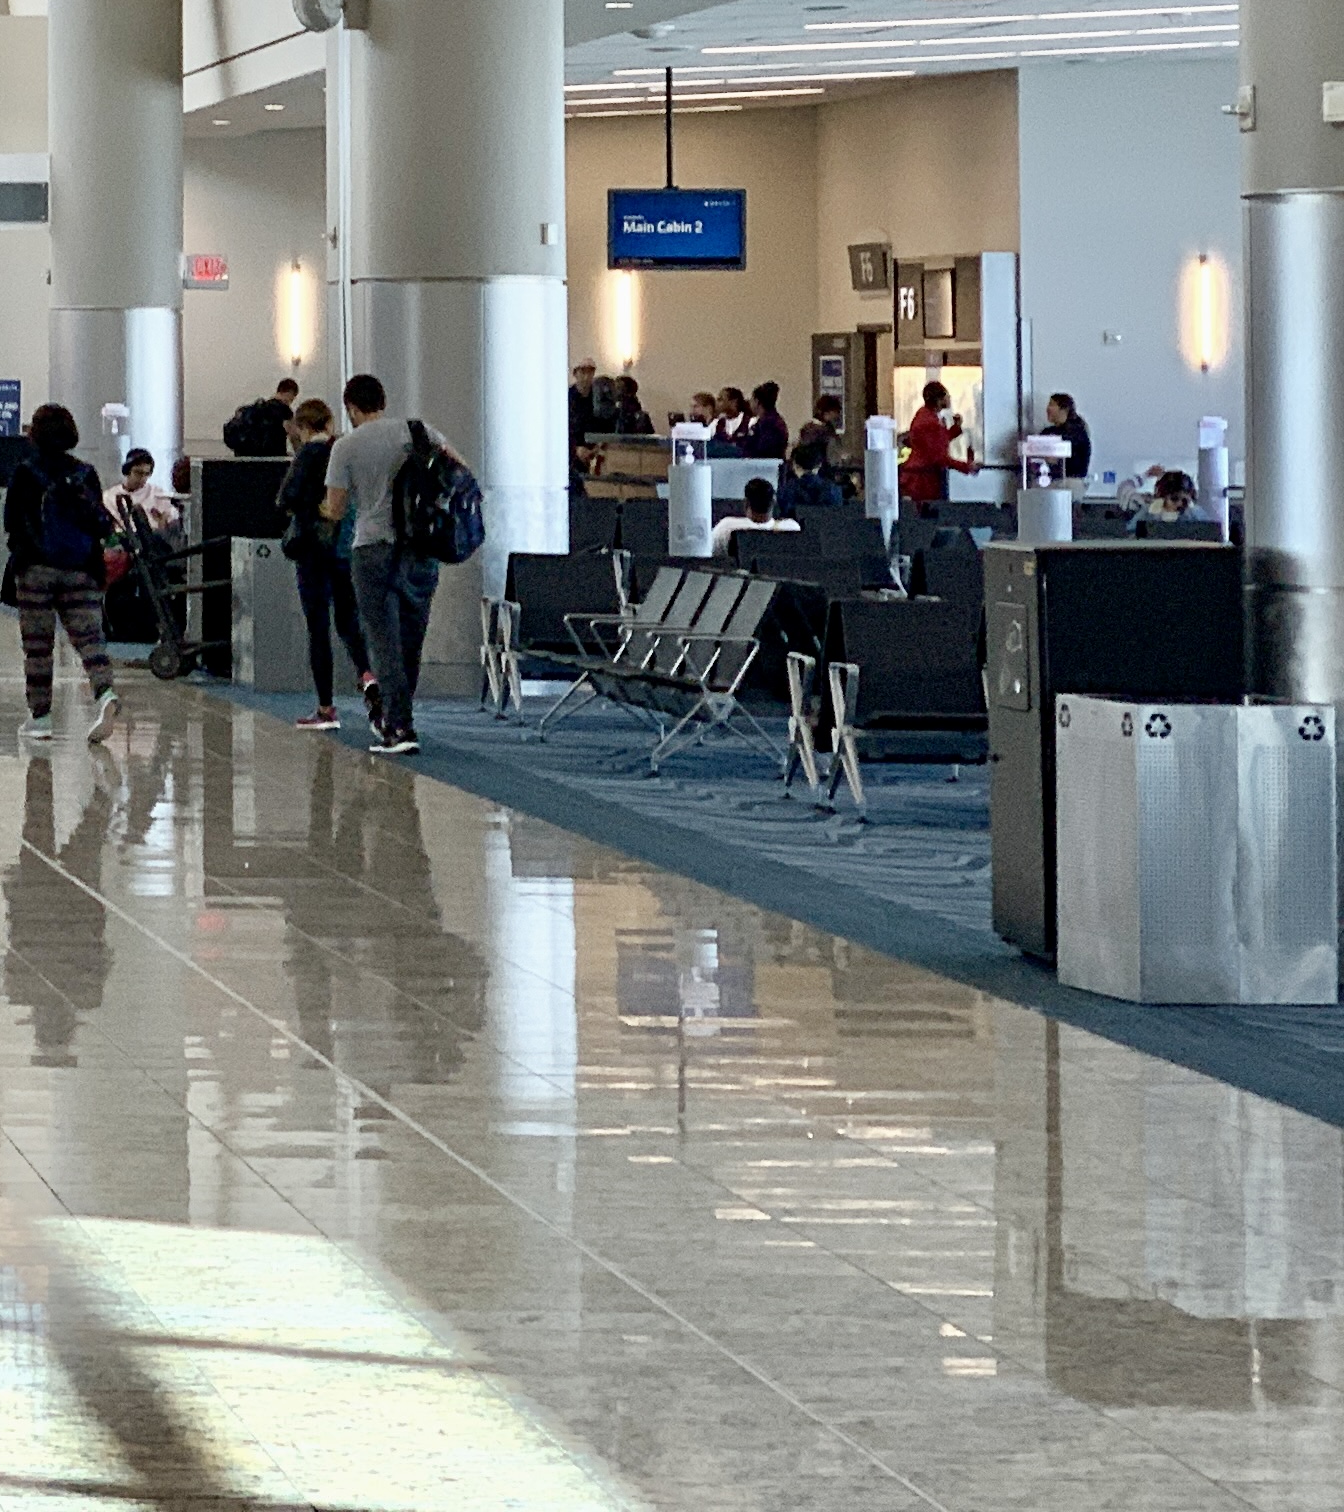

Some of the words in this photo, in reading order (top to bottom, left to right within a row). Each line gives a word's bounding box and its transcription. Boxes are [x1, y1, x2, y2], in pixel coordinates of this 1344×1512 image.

[623, 221, 655, 234] Main
[657, 220, 693, 234] Cabin
[695, 220, 704, 234] 2
[900, 286, 915, 321] F6
